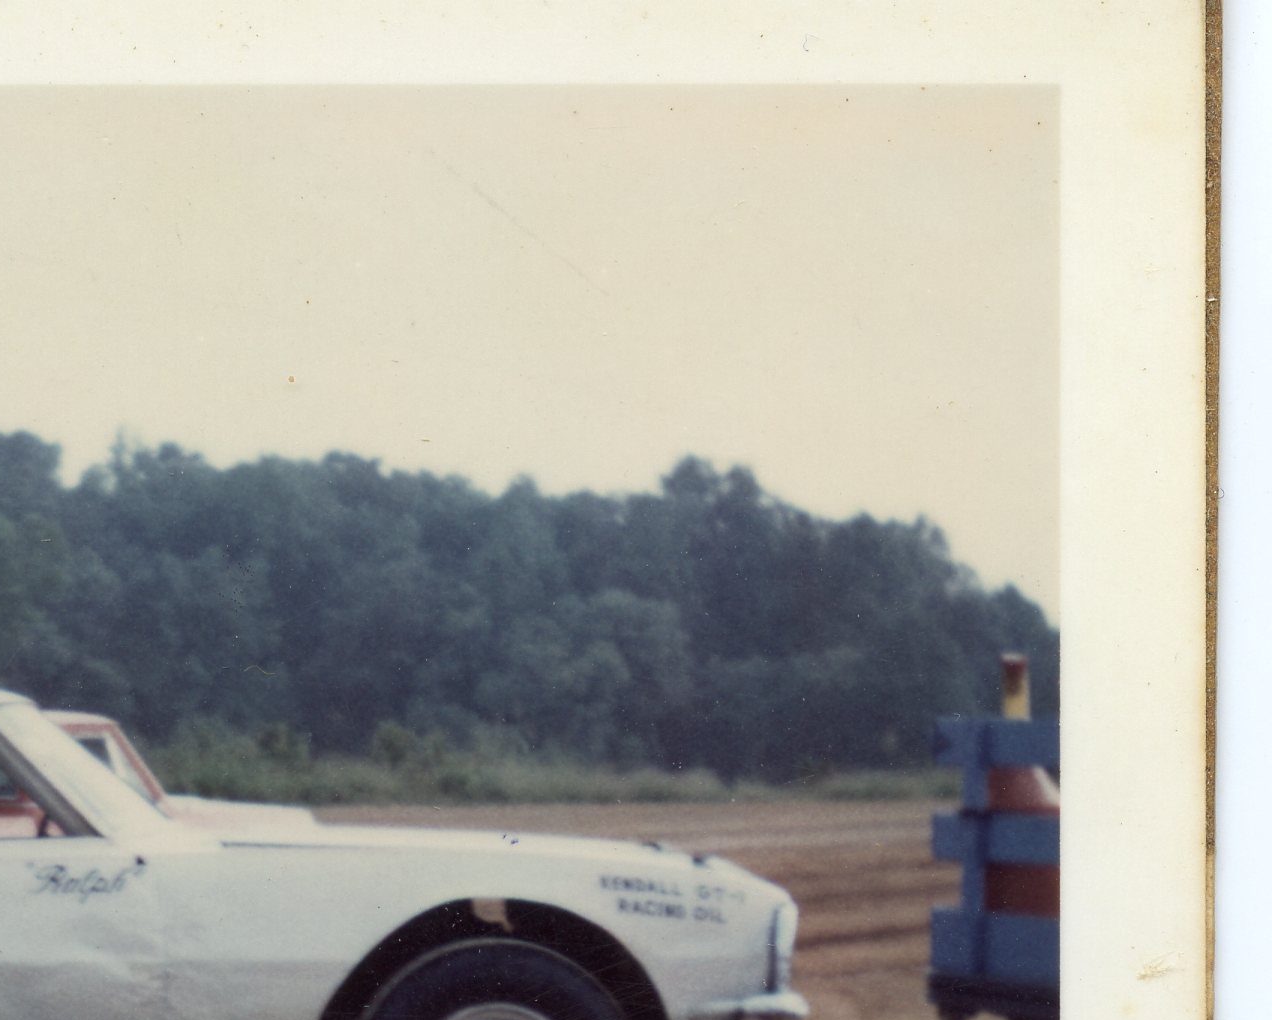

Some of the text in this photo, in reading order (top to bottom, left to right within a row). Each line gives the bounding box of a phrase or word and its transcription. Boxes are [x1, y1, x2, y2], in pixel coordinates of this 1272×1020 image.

[600, 875, 682, 896] KENDALL
[617, 897, 726, 924] RACING OIL
